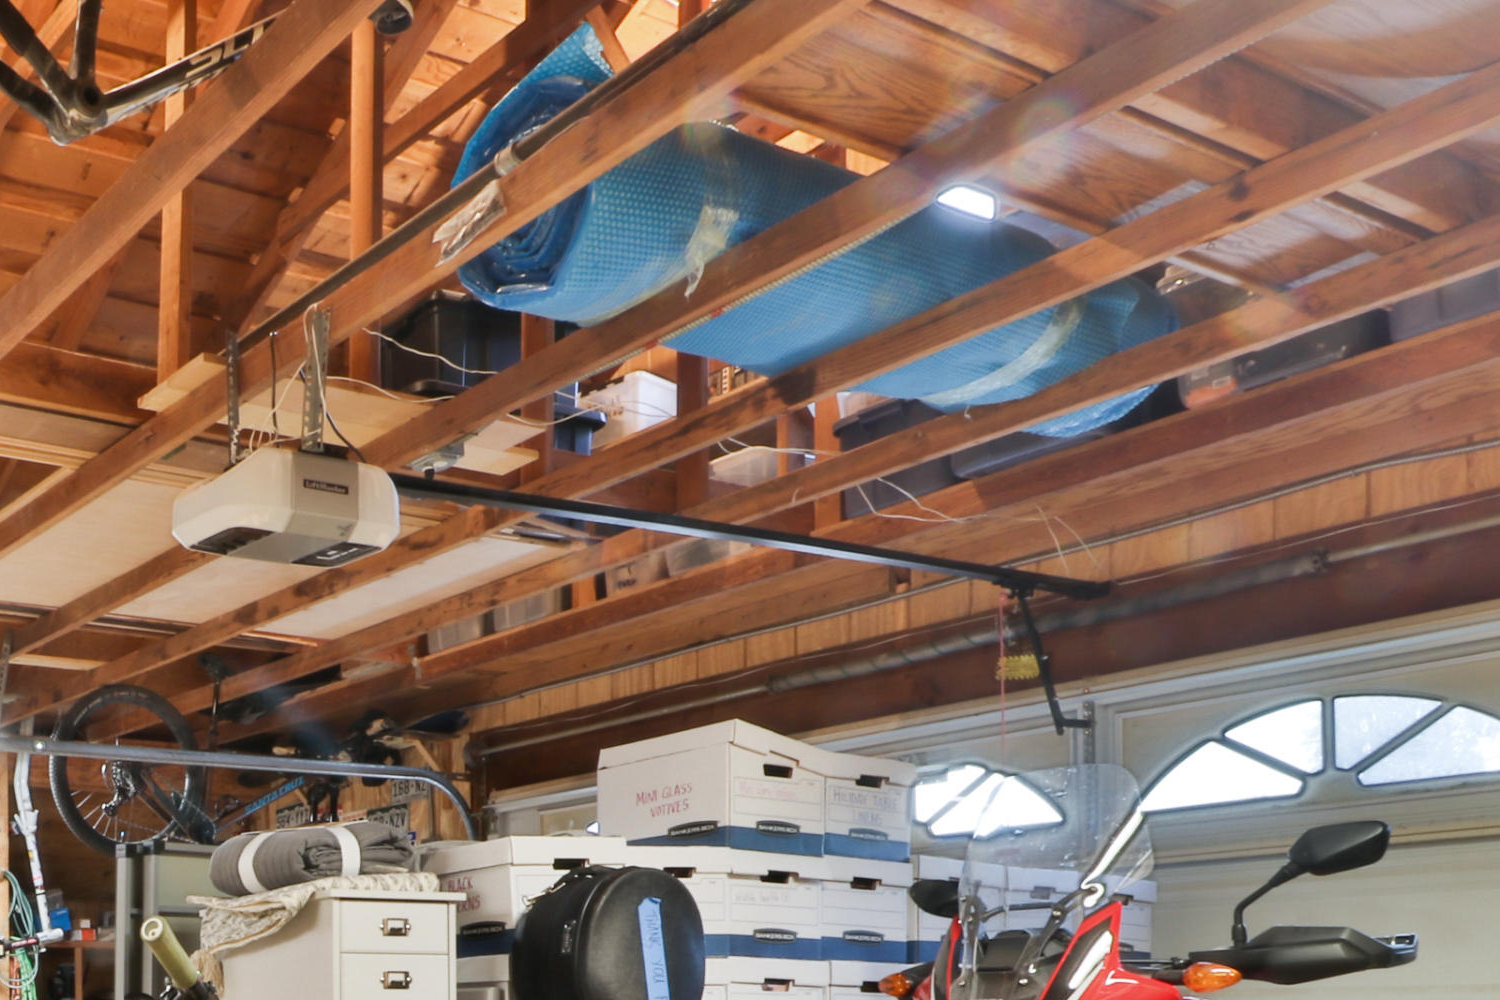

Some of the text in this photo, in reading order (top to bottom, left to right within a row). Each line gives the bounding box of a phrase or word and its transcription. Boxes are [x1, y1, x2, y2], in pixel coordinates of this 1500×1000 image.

[245, 776, 304, 815] SANTA CRUZ
[661, 782, 693, 799] GLASS
[650, 798, 690, 818] VOTIVES
[651, 958, 666, 983] YOU
